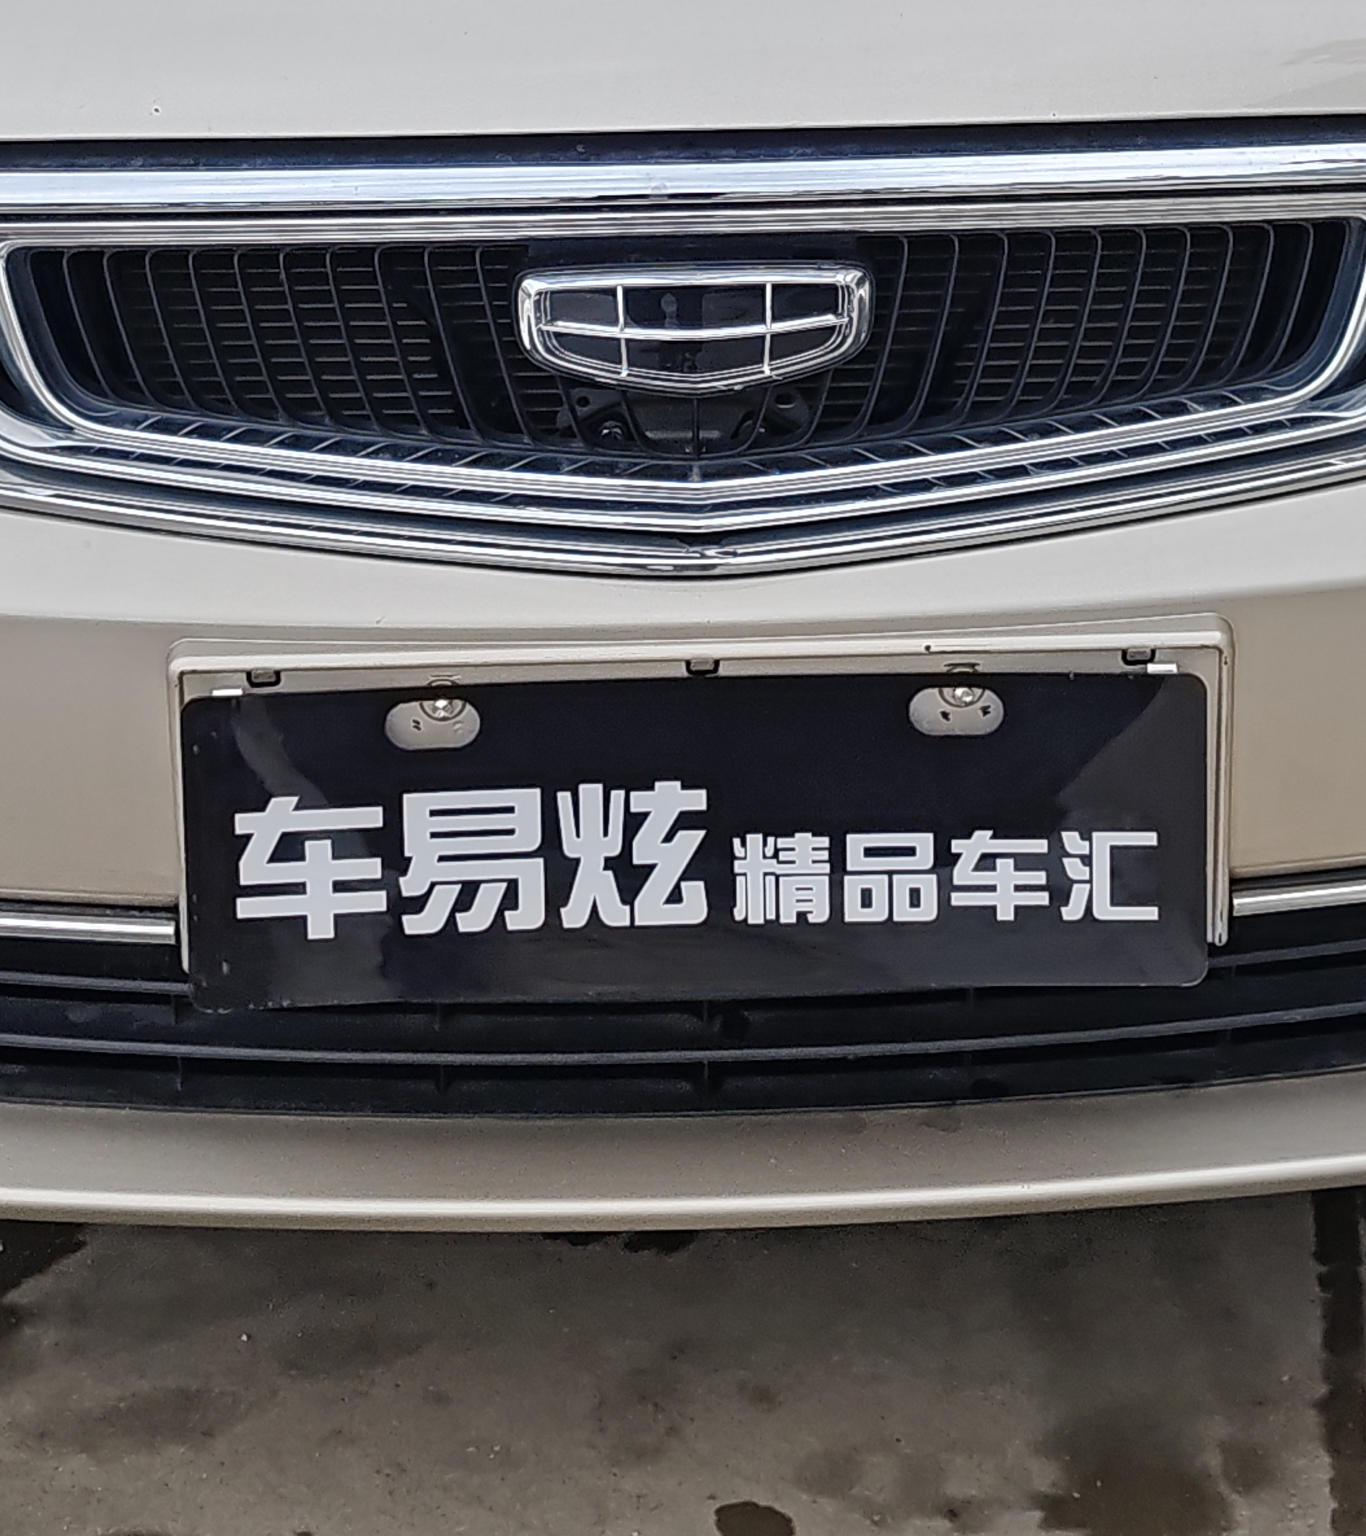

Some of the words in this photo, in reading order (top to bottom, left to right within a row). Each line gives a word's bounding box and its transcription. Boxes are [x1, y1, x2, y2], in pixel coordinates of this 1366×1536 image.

[233, 780, 708, 940] 车易炫
[732, 829, 1160, 925] 精品车汇
